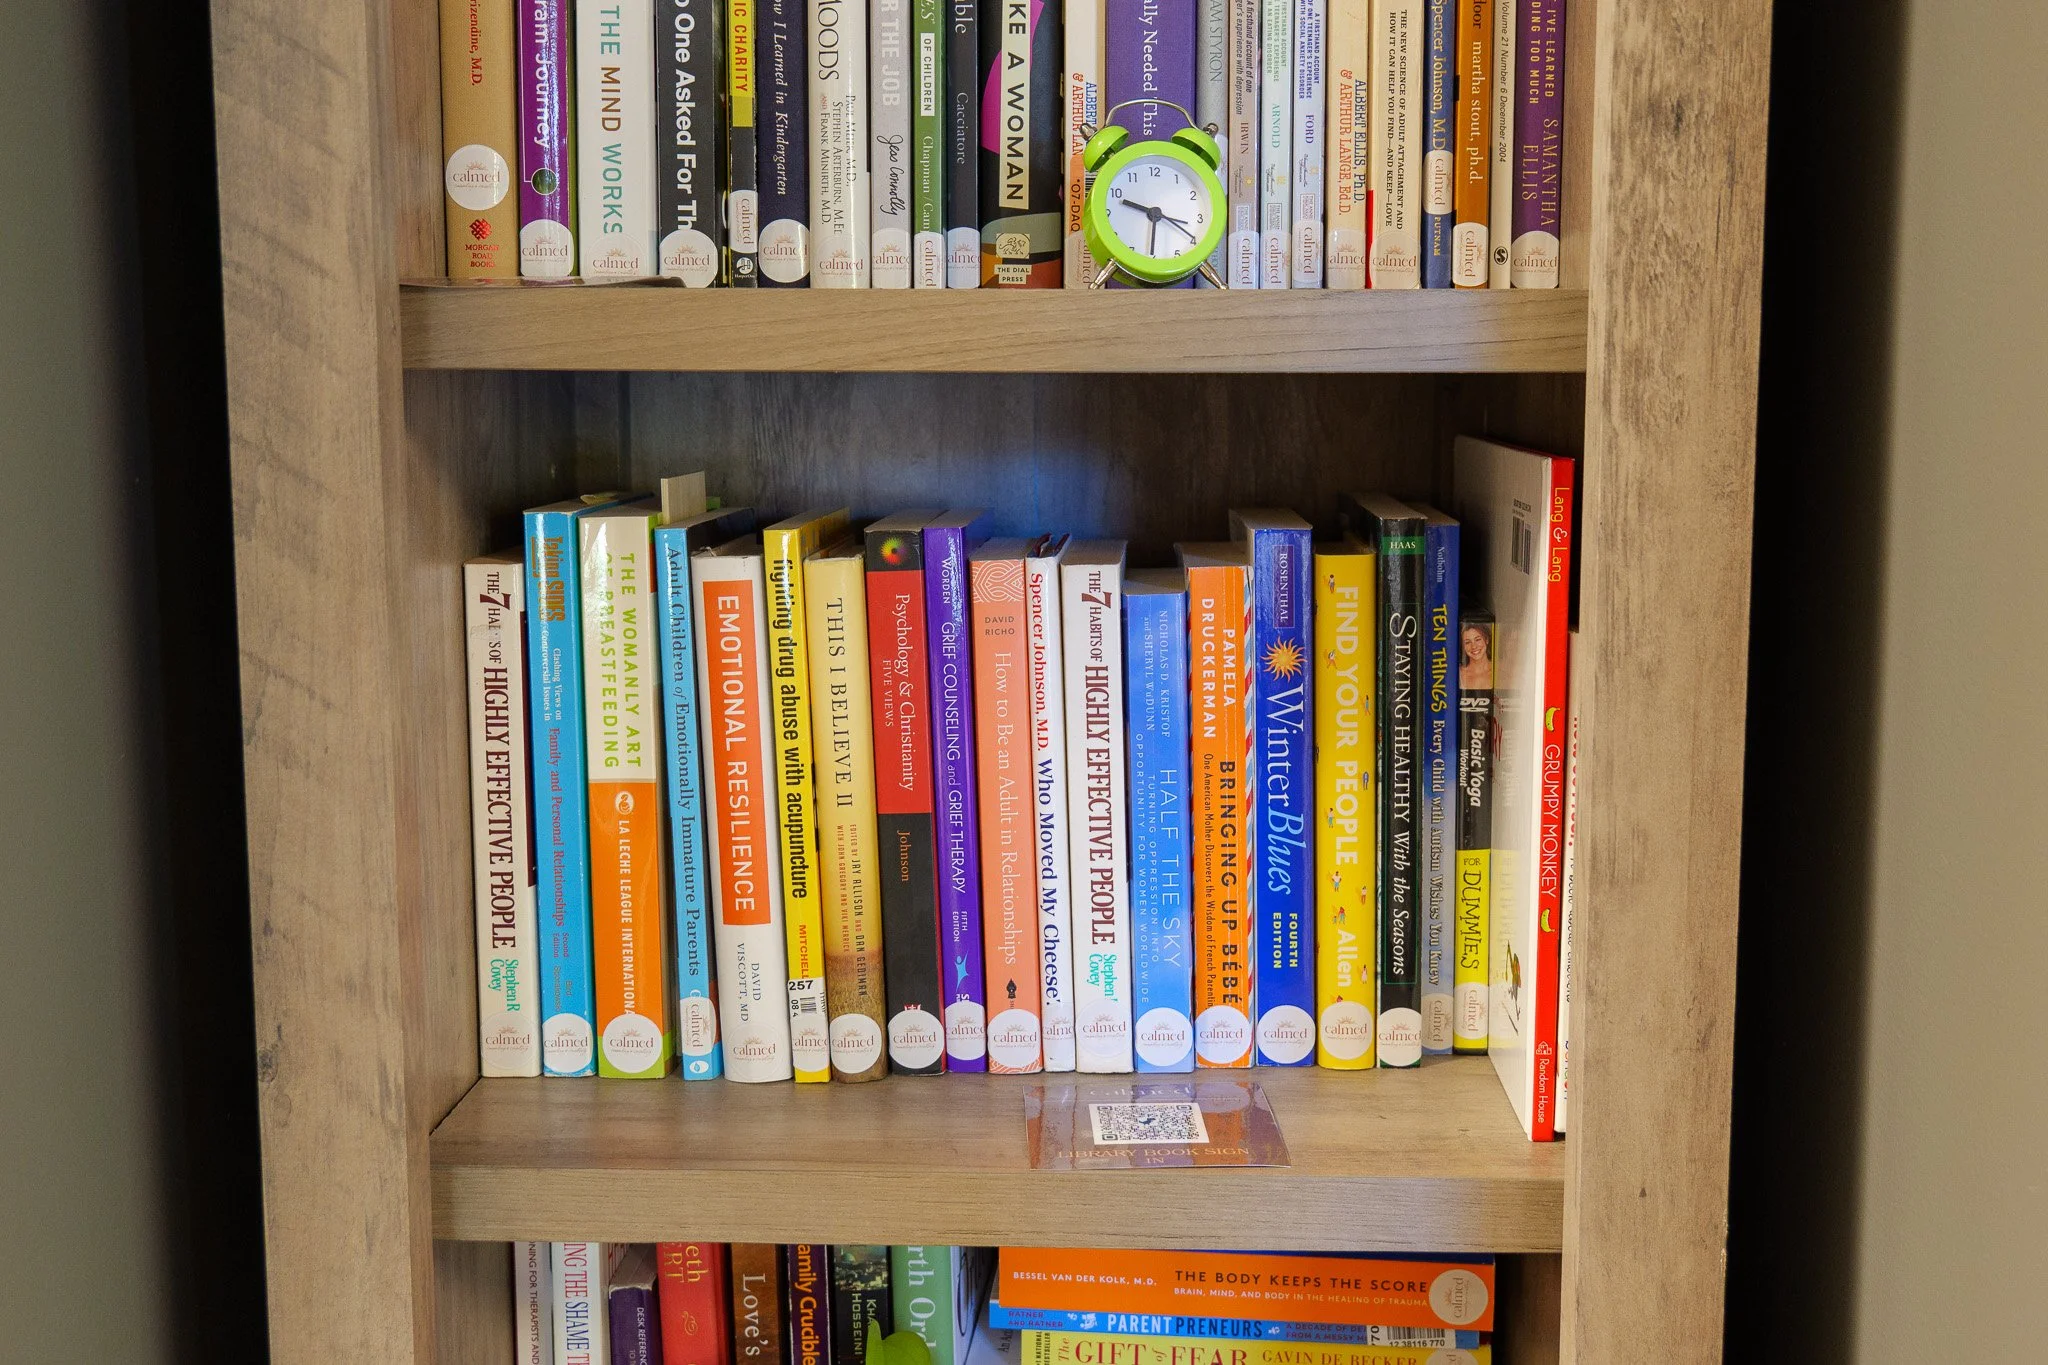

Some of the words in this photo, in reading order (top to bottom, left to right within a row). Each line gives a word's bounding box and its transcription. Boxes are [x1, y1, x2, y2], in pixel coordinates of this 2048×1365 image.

[601, 6, 619, 54] THE
[675, 16, 695, 63] One
[882, 19, 899, 58] THE
[924, 39, 931, 52] OF
[1209, 26, 1222, 81] STYRON
[1531, 40, 1540, 62] TOO
[734, 25, 748, 92] CHARITY
[774, 33, 787, 86] Learned
[1008, 53, 1024, 70] A
[1341, 70, 1351, 78] &
[1473, 42, 1485, 94] martha
[601, 67, 620, 131] MIND
[676, 70, 695, 145] Asked
[776, 91, 786, 104] in
[882, 65, 899, 106] JOB
[923, 56, 932, 111] CHILDREN
[1355, 80, 1366, 128] ALBERT
[1400, 98, 1406, 108] OF
[1530, 70, 1540, 104] MUCH
[957, 93, 968, 164] Cacciatore
[1272, 104, 1281, 148] ARNOLD
[1306, 115, 1314, 143] FORD
[1341, 82, 1352, 136] ARTHUR
[1472, 100, 1482, 142] stout,
[774, 112, 787, 195] Kindergarten
[1007, 83, 1024, 200] WOMAN
[1240, 122, 1248, 154] IRWIN
[1340, 141, 1351, 183] LANGE,
[1354, 131, 1366, 170] ELLIS,
[602, 143, 623, 234] WORKS
[676, 154, 696, 194] For
[920, 136, 933, 193] Chapman
[1128, 173, 1137, 182] 11
[1149, 167, 1160, 176] 12
[1467, 148, 1482, 184] ph.d.
[1523, 145, 1538, 200] ELLIS
[1541, 118, 1558, 226] SAMANTHA
[1111, 188, 1122, 198] 10
[1190, 191, 1196, 200] 2
[1339, 188, 1350, 215] Ed.D.
[1354, 175, 1364, 203] Ph.D.
[1197, 214, 1203, 223] 3
[1550, 487, 1569, 523] Lang
[1390, 541, 1416, 549] HAAS
[1552, 528, 1568, 542] &
[621, 554, 635, 594] THE
[668, 548, 680, 598] Adult
[1279, 553, 1288, 622] ROSENTHAL
[1547, 547, 1568, 583] Lang
[769, 560, 792, 632] fighting
[1335, 586, 1359, 654] FIND
[670, 604, 685, 681] Children
[827, 598, 845, 657] THIS
[894, 594, 913, 676] Psychology
[942, 622, 956, 660] GRIEF
[622, 608, 639, 716] WOMANLY
[718, 595, 747, 752] EMOTIONAL
[776, 636, 797, 678] drug
[882, 660, 892, 687] FIVE
[996, 652, 1012, 693] How
[1201, 598, 1216, 738] DRUCKERMAN
[1223, 628, 1236, 707] PAMELA
[1389, 613, 1417, 718] STAYING
[484, 667, 509, 746] HIGHLY
[673, 687, 685, 699] of
[781, 685, 799, 741] abuse
[884, 691, 893, 727] VIEWS
[900, 682, 914, 696] &
[943, 665, 960, 760] COUNSELING
[997, 700, 1008, 717] to
[1335, 663, 1359, 749] YOUR
[626, 726, 641, 767] ART
[674, 702, 696, 810] Emotionally
[830, 684, 852, 784] BELIEVE
[900, 701, 918, 791] Christianity
[998, 724, 1014, 744] Be
[785, 747, 804, 786] with
[948, 765, 961, 786] and
[999, 750, 1010, 769] an
[1394, 722, 1411, 822] HEALTHY
[1543, 744, 1561, 820] GRUMPY
[486, 750, 513, 865] EFFECTIVE
[836, 793, 853, 807] II
[949, 790, 963, 827] GRIEF
[998, 772, 1019, 824] Adult
[1160, 770, 1178, 840] HALF
[1335, 760, 1358, 866] PEOPLE
[727, 761, 755, 911] RESILIENCE
[784, 792, 809, 899] acupuncture
[1000, 832, 1012, 845] in
[1220, 760, 1237, 887] BRINGING
[681, 815, 695, 902] Immature
[896, 830, 909, 881] Johnson
[950, 832, 966, 893] THERAPY
[1394, 830, 1411, 871] With
[1463, 858, 1481, 866] FOR
[1540, 820, 1558, 898] MONKEY
[1162, 855, 1180, 905] THE
[1394, 874, 1406, 905] the
[490, 871, 516, 948] PEOPLE
[1000, 851, 1023, 965] Relationships
[1222, 901, 1237, 931] UP
[1460, 871, 1482, 972] DUMMIES
[686, 908, 700, 976] Parents
[1163, 917, 1181, 968] SKY
[1273, 912, 1282, 969] EDITION
[1290, 913, 1298, 968] FOURTH
[1337, 928, 1359, 987] Allen
[1393, 908, 1410, 976] Seasons
[751, 963, 761, 1000] DAVID
[789, 980, 814, 991] 257
[1222, 944, 1242, 1005] BÉBÉ
[1538, 1058, 1548, 1094] Random
[1537, 1096, 1548, 1123] House
[1204, 1148, 1249, 1156] SIGN
[564, 1270, 577, 1298] THE
[1013, 1272, 1047, 1280] BESSEL
[1052, 1273, 1072, 1281] VAN
[1076, 1275, 1095, 1283] DER
[1100, 1276, 1130, 1285] KOLK,
[1134, 1277, 1157, 1286] M.D.
[1174, 1288, 1206, 1296] BRAIN,
[1209, 1289, 1238, 1298] MIND,
[1265, 1292, 1290, 1300] BODY
[1328, 1295, 1370, 1304] HEALING
[1389, 1298, 1428, 1306] TRAUMA
[1176, 1270, 1206, 1282] THE
[1215, 1272, 1261, 1285] BODY
[1270, 1275, 1321, 1288] KEEPS
[1330, 1278, 1362, 1290] THE
[1370, 1279, 1427, 1293] SCORE
[566, 1301, 579, 1350] SHAME
